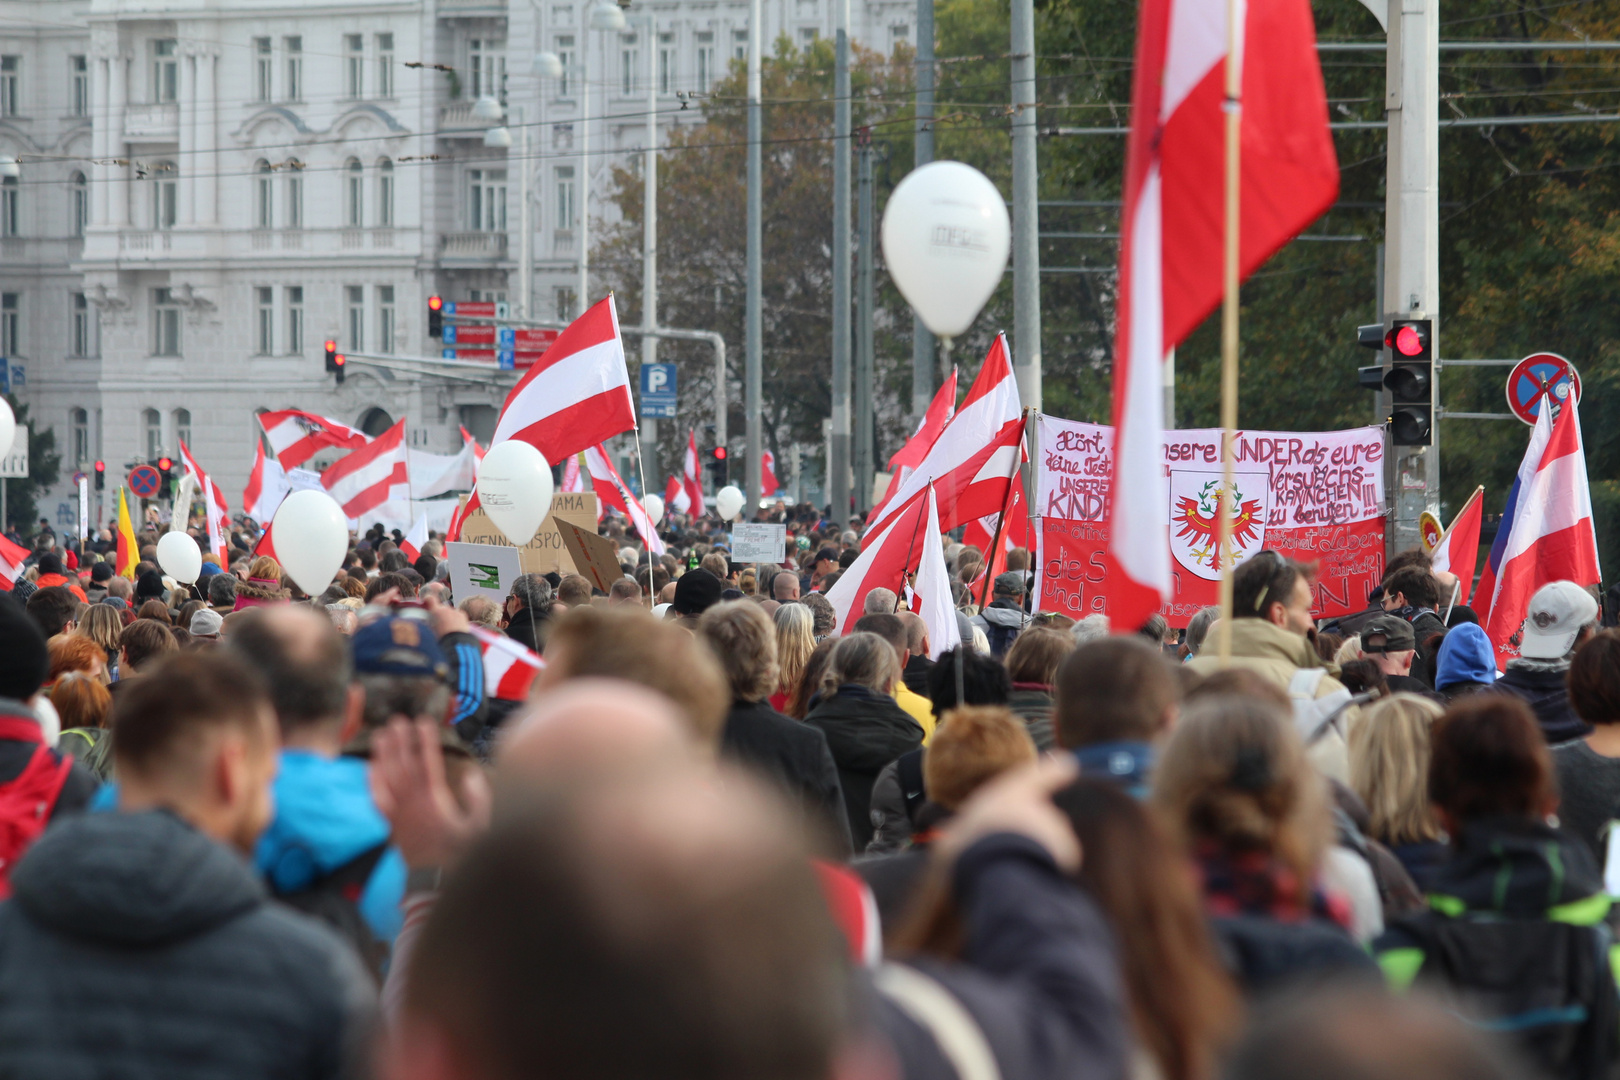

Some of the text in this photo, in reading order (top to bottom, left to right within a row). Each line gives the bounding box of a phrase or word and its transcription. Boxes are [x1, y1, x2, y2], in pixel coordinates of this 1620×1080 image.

[1056, 430, 1106, 454] Hört
[1161, 443, 1218, 463] nsere
[1330, 442, 1382, 465] eure
[1047, 489, 1112, 521] KINDE
[1275, 483, 1362, 507] KANINCHEN
[1267, 508, 1286, 526] zu
[1071, 523, 1110, 541] öffne
[1319, 526, 1381, 552] Leben
[1045, 546, 1084, 580] die
[1044, 581, 1084, 612] und
